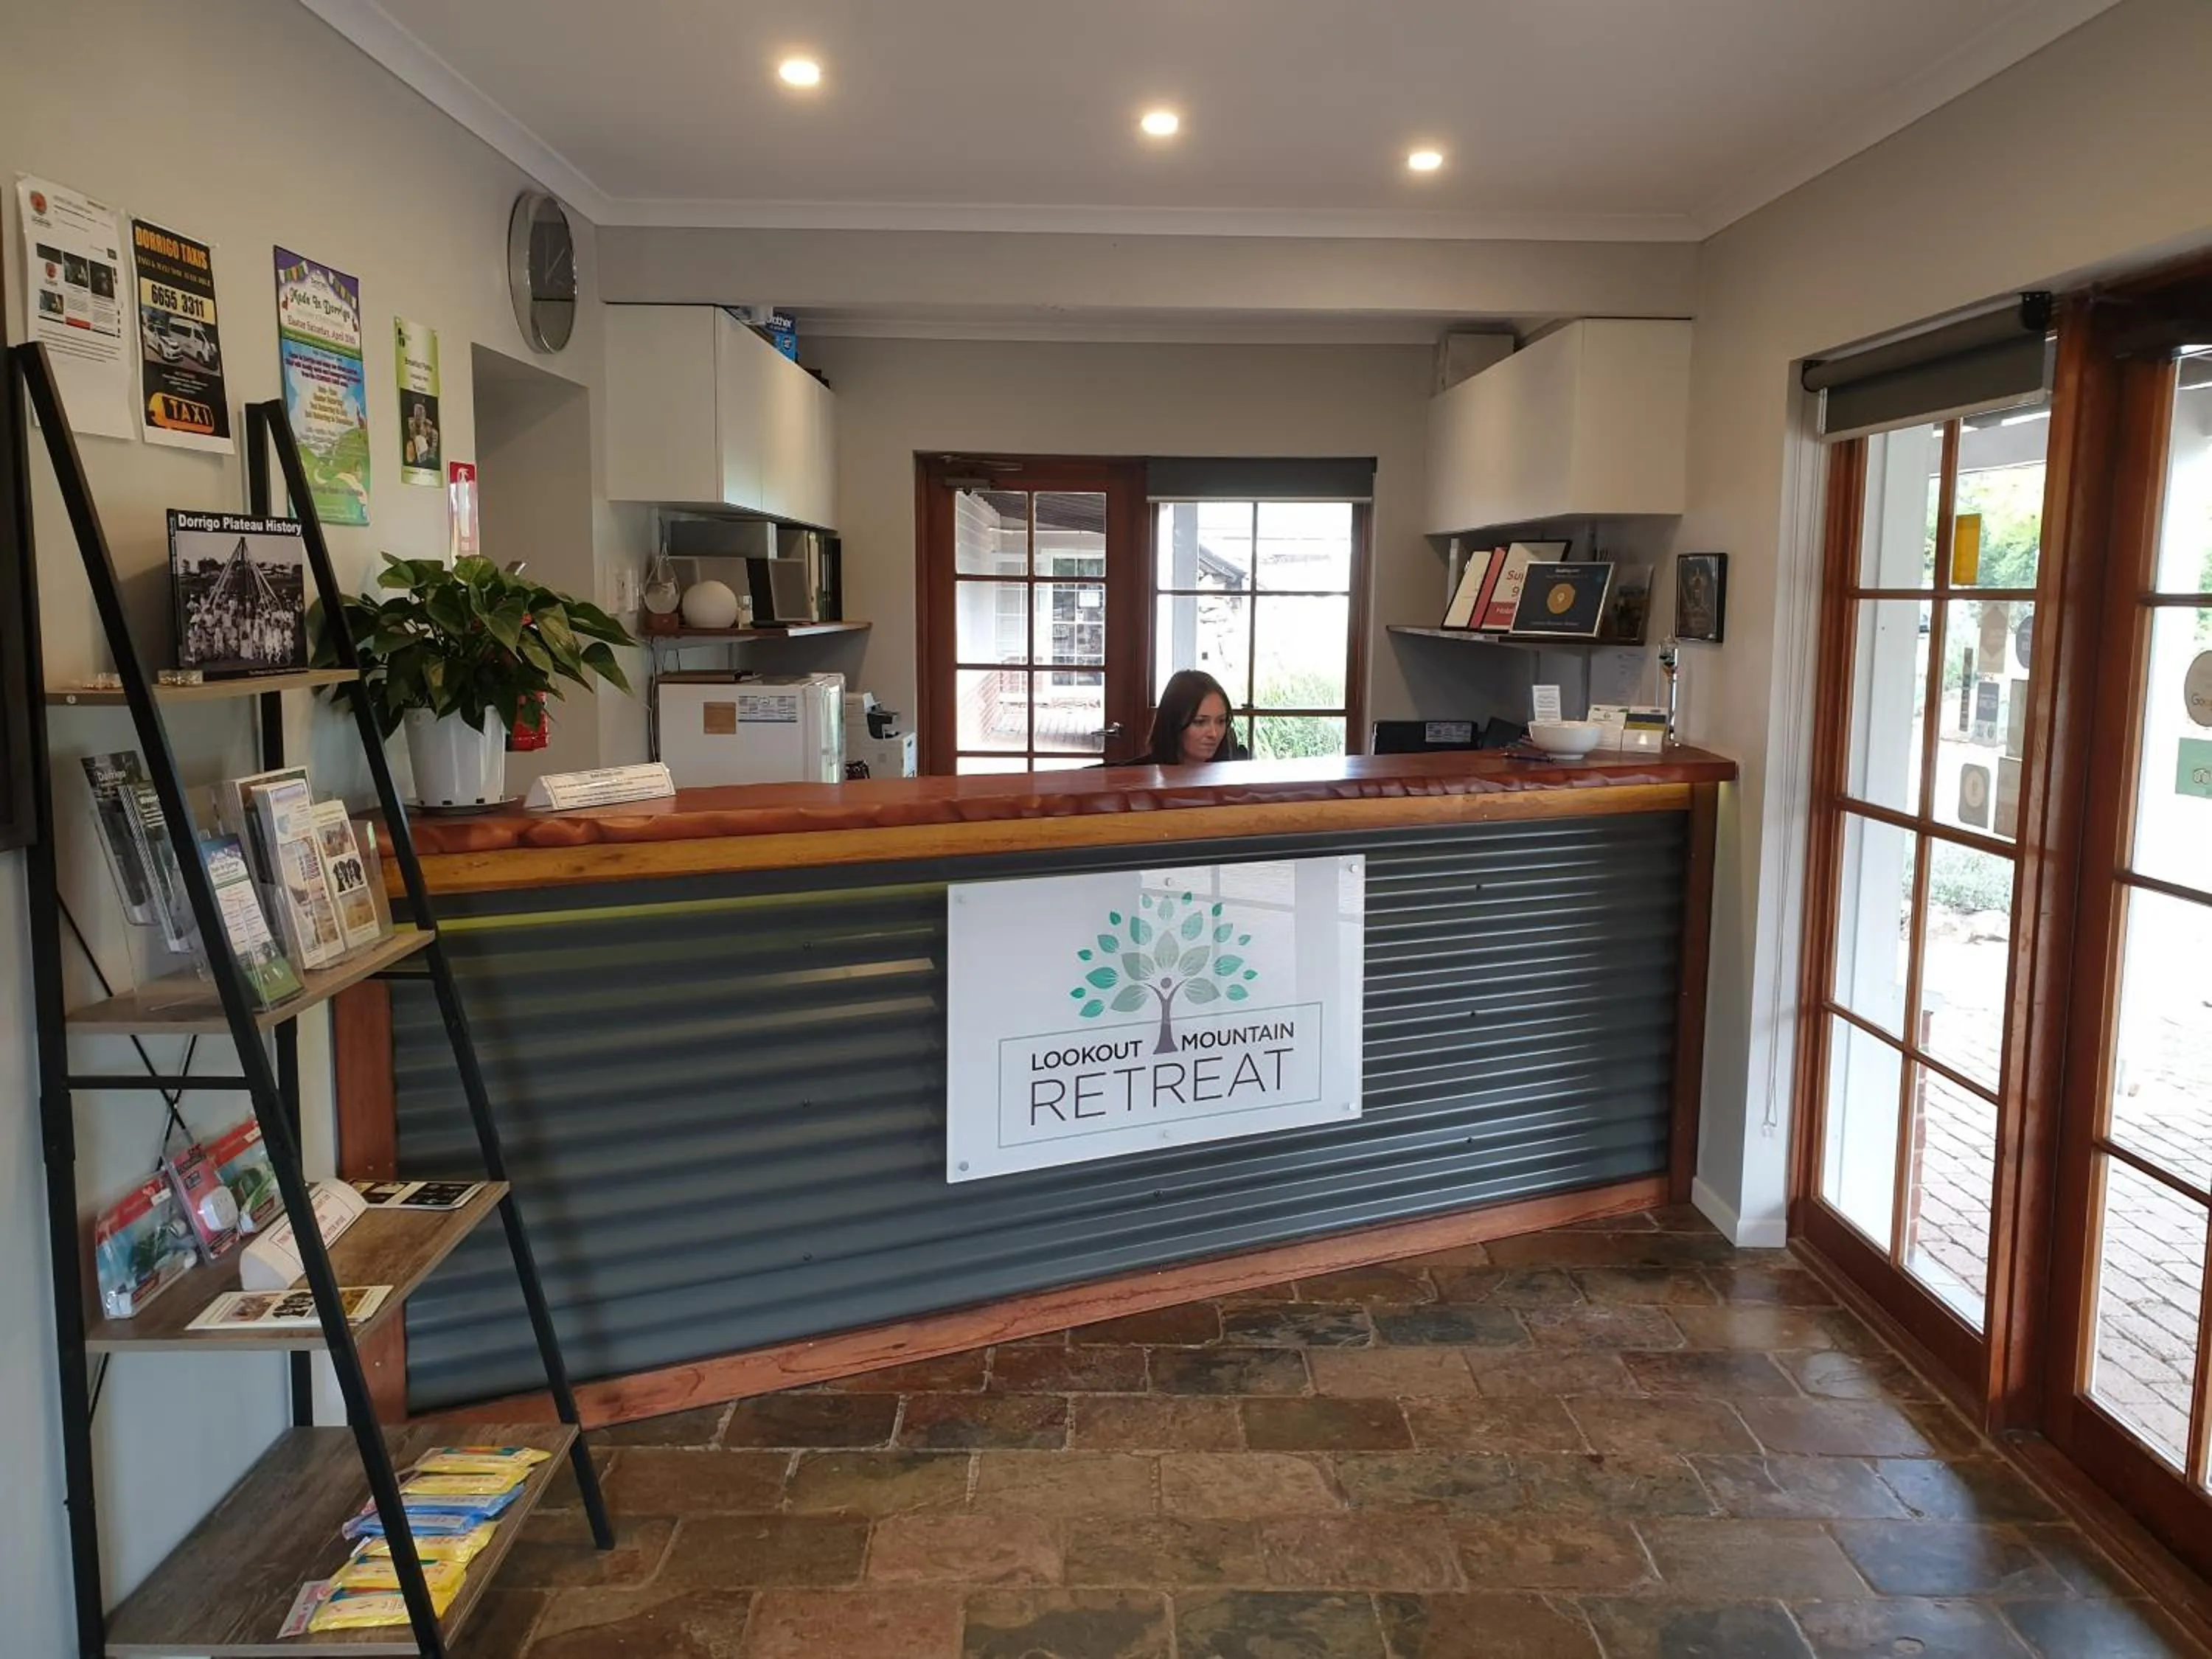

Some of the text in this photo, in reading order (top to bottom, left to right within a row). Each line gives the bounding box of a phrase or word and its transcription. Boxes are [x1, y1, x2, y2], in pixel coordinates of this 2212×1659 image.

[135, 225, 208, 271] DORRIGO TAXIS
[151, 284, 204, 319] 6655 3311
[169, 399, 209, 425] TAXI
[178, 513, 302, 536] Dorrigo Plateau History
[1032, 1021, 1295, 1071] LOOKOUT MOUNTAIN
[1030, 1048, 1294, 1127] RETREAT
